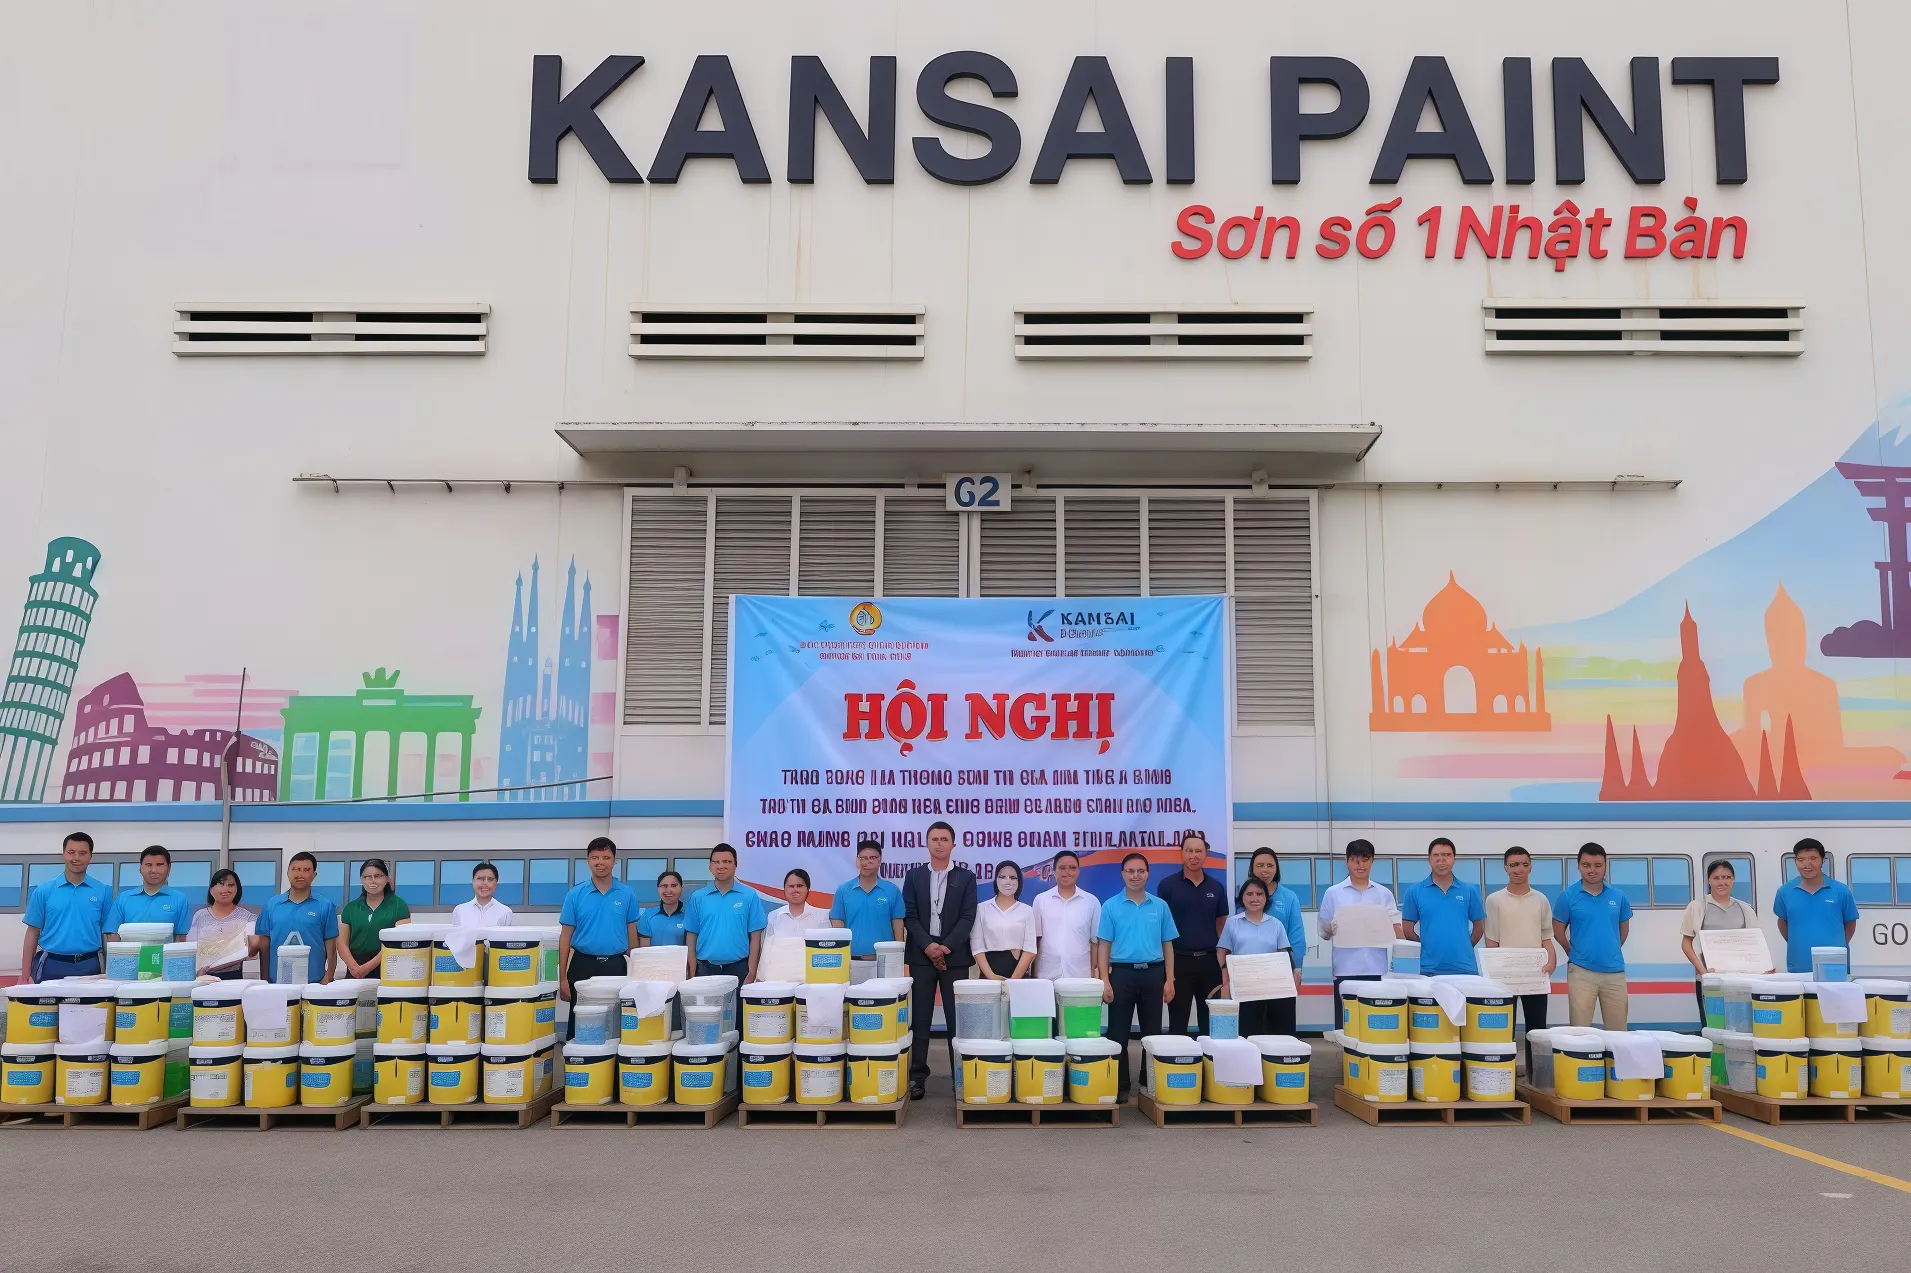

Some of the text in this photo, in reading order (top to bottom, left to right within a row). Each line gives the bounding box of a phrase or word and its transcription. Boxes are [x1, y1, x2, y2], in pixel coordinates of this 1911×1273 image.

[528, 51, 1780, 186] KANSAI PAINT
[1171, 205, 1301, 259] Sơn
[1315, 196, 1402, 259] số
[1417, 205, 1442, 258] 1
[1454, 199, 1612, 272] Nhật
[954, 475, 1001, 507] G2
[843, 679, 1116, 757] HỘI NGHỊ
